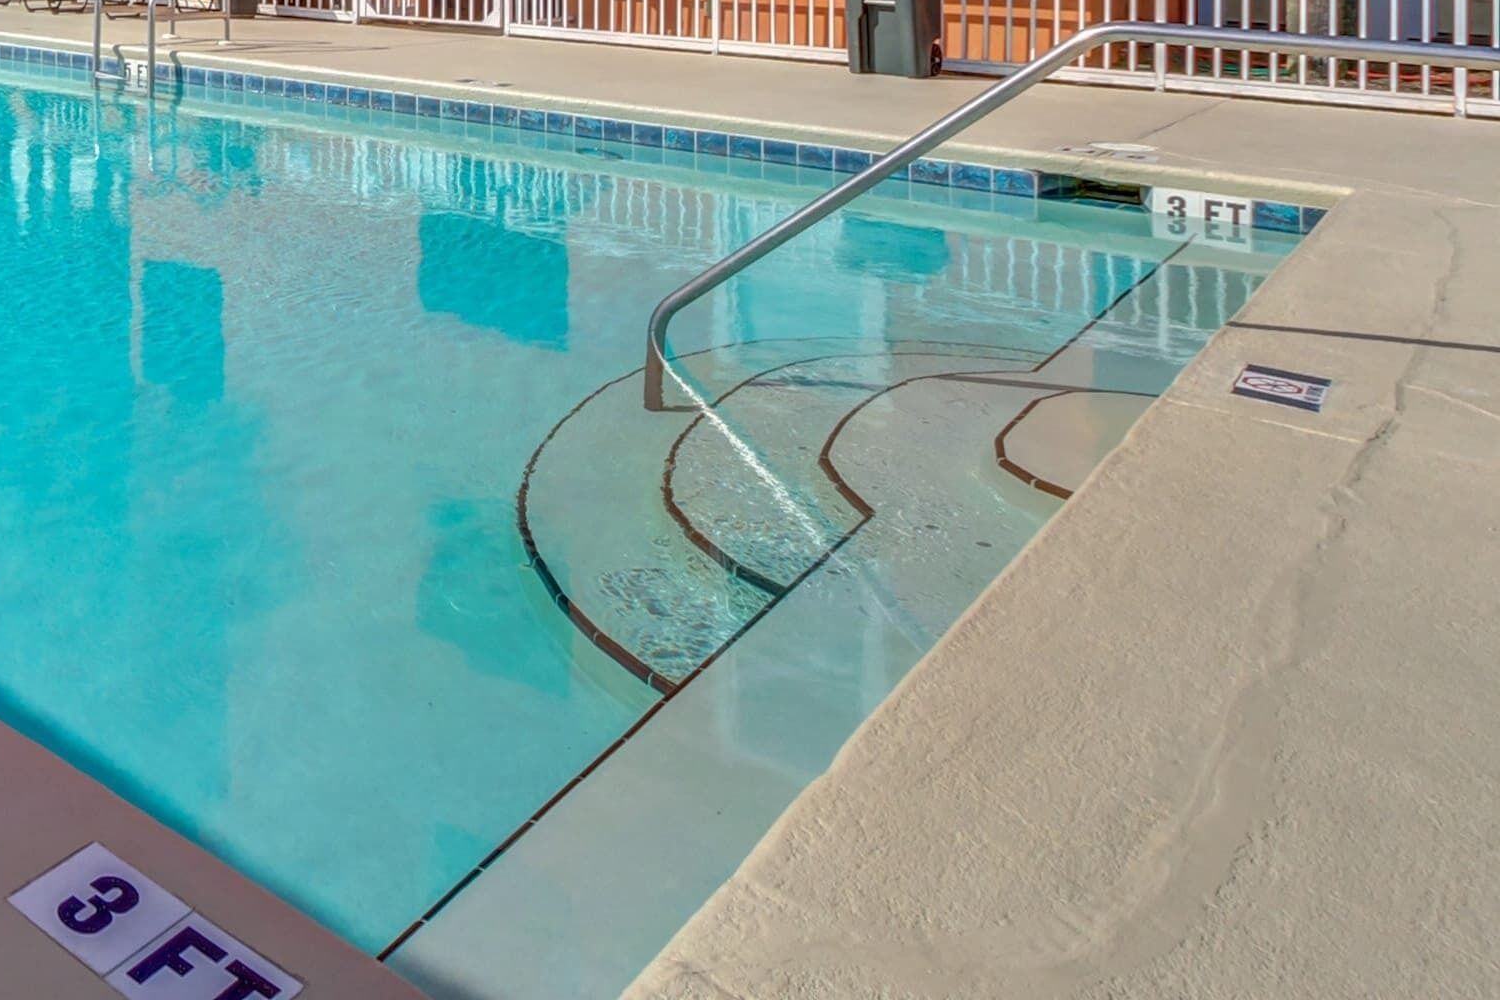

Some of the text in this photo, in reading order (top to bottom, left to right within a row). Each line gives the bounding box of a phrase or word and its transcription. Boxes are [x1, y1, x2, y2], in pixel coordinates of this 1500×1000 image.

[1167, 195, 1247, 225] 3 FT
[57, 875, 140, 935] 3
